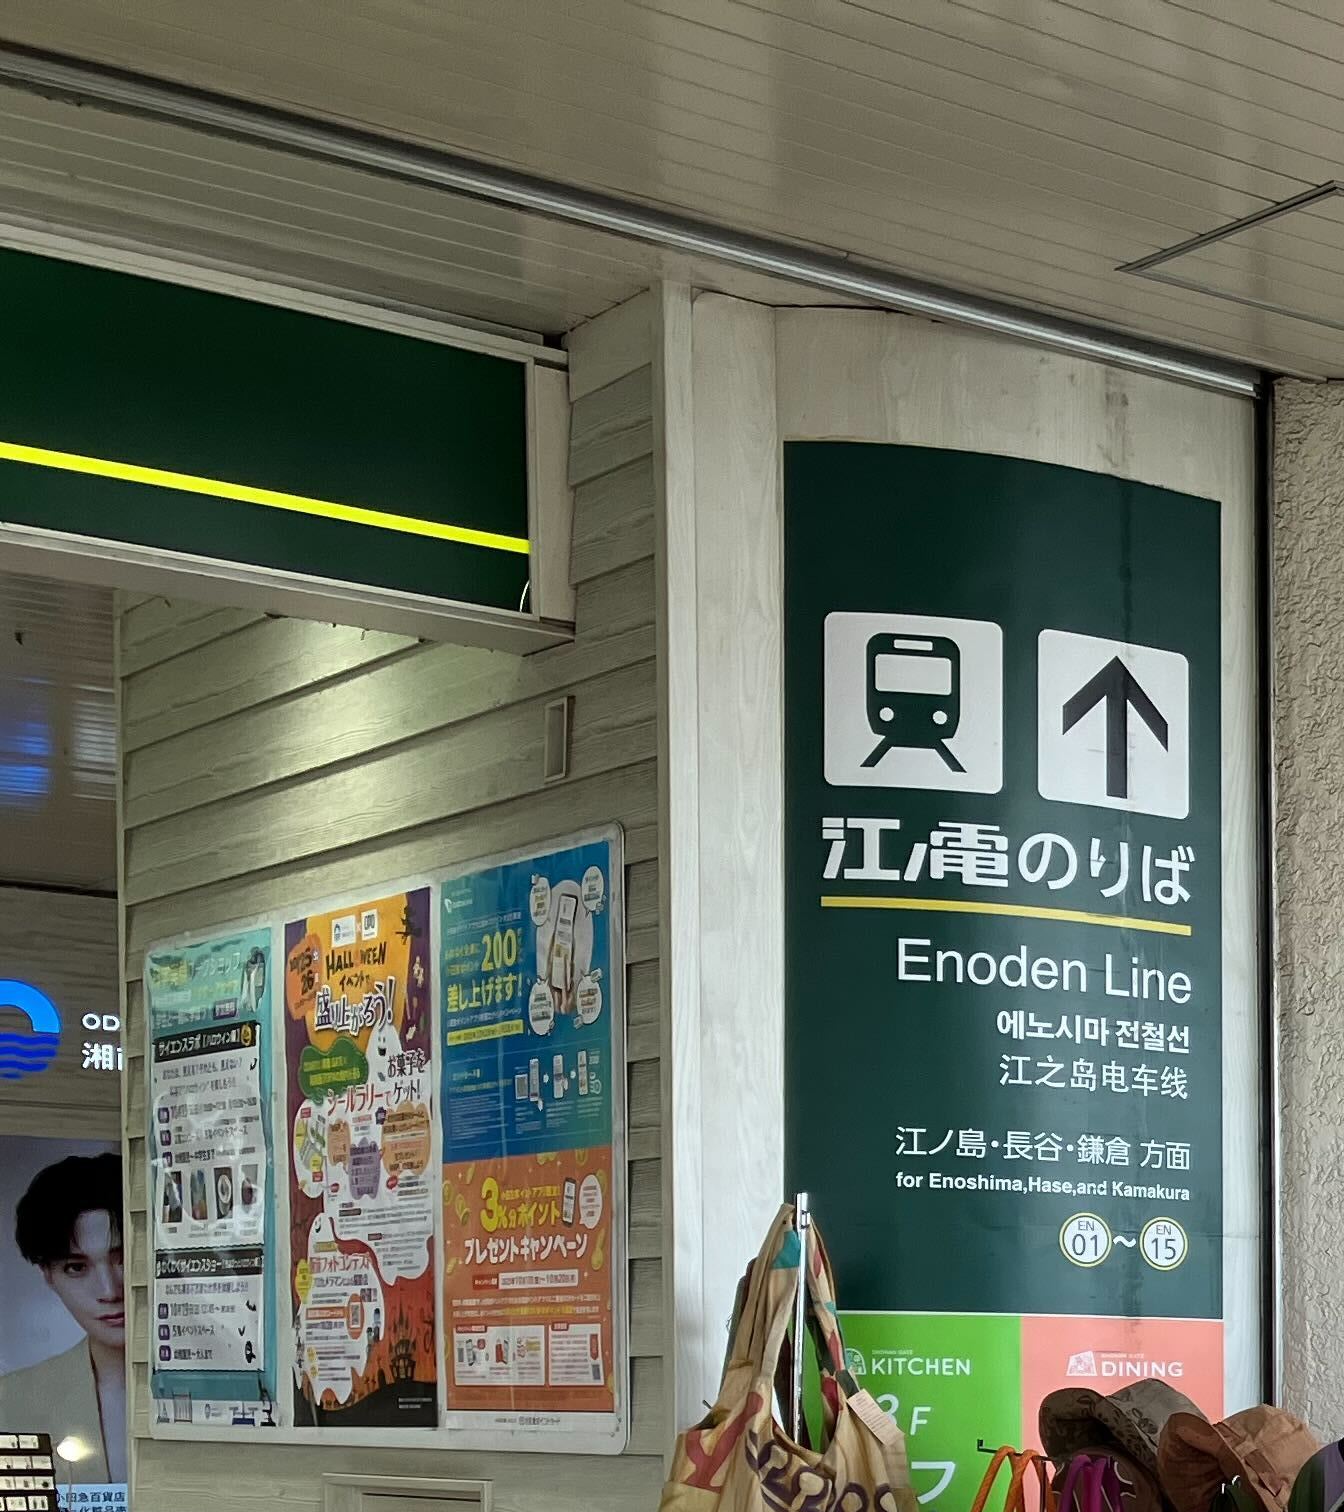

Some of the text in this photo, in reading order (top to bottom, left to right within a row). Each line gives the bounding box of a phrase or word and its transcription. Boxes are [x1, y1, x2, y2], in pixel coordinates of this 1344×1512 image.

[822, 817, 1196, 905] 江ノ電のりば
[482, 928, 517, 971] 200
[899, 938, 1192, 1004] Enoden Line
[997, 1010, 1191, 1054] 에노시마 전철선
[82, 1042, 123, 1071] 湘
[1000, 1055, 1188, 1099] 江之岛电车线
[1139, 1140, 1191, 1171] 方面
[896, 1171, 923, 1189] for
[1112, 1182, 1191, 1201] Kamakura
[1078, 1220, 1172, 1236] EN EN
[1071, 1233, 1100, 1257] 01
[1150, 1237, 1177, 1262] 15
[871, 1358, 971, 1376] KITCHEN
[1101, 1361, 1184, 1377] DINING
